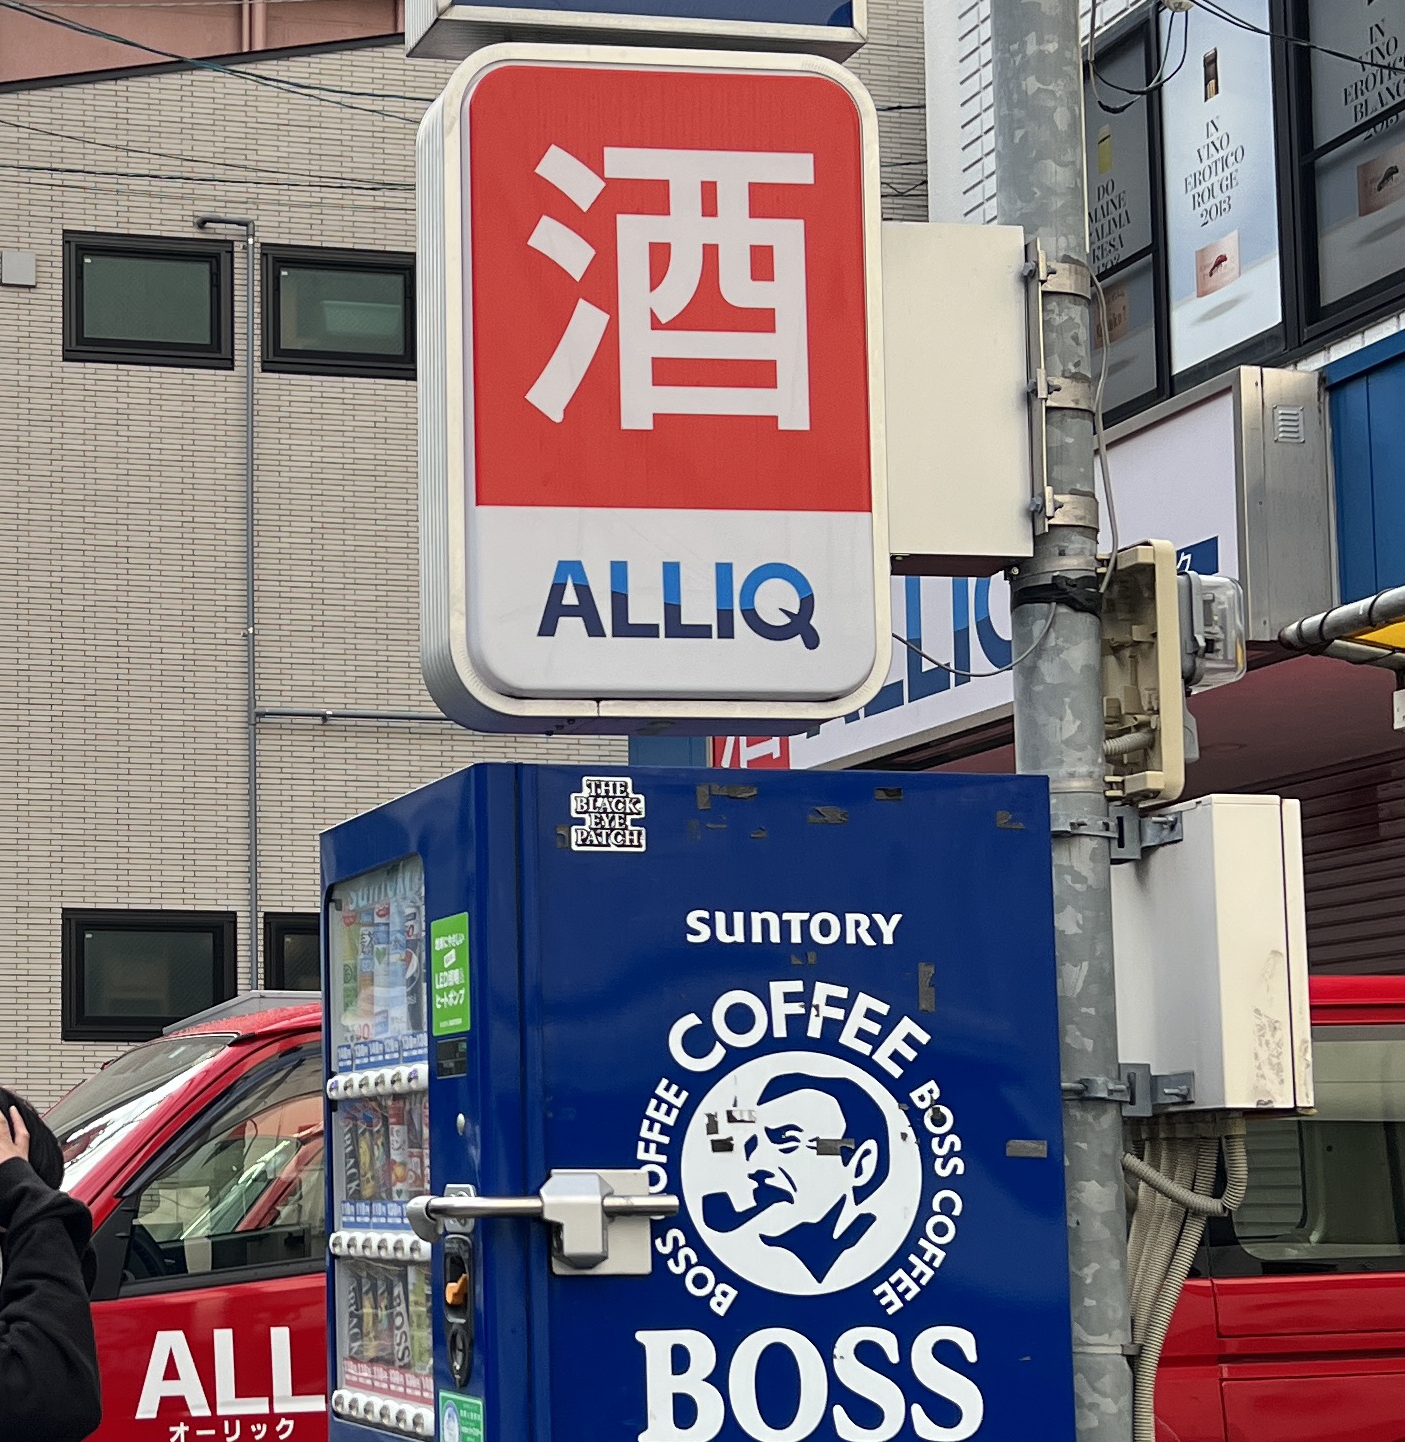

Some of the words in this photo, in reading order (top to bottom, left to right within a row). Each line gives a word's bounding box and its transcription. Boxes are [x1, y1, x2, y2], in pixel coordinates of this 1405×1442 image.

[1369, 17, 1386, 45] IN
[1358, 35, 1398, 72] VINO
[1343, 55, 1405, 106] EROTIC
[1205, 115, 1220, 140] IN
[1196, 131, 1231, 165] VINO
[1183, 144, 1245, 195] EROTICO
[1097, 178, 1115, 202] DO
[1191, 168, 1240, 212] ROUGE
[1199, 195, 1233, 228] 2013
[524, 143, 815, 431] 酒
[537, 559, 821, 651] ALLIQ
[575, 797, 640, 814] BLACK
[586, 780, 630, 797] THE
[575, 829, 642, 847] PATCH
[589, 813, 628, 829] EYE
[685, 909, 903, 946] SUNTORY
[668, 980, 932, 1079] COFFEE
[636, 1077, 690, 1219] OFFEE
[909, 1079, 965, 1178] BOSS
[655, 1228, 738, 1317] BOSS
[872, 1189, 964, 1316] COFFEE
[135, 1326, 327, 1420] ALL
